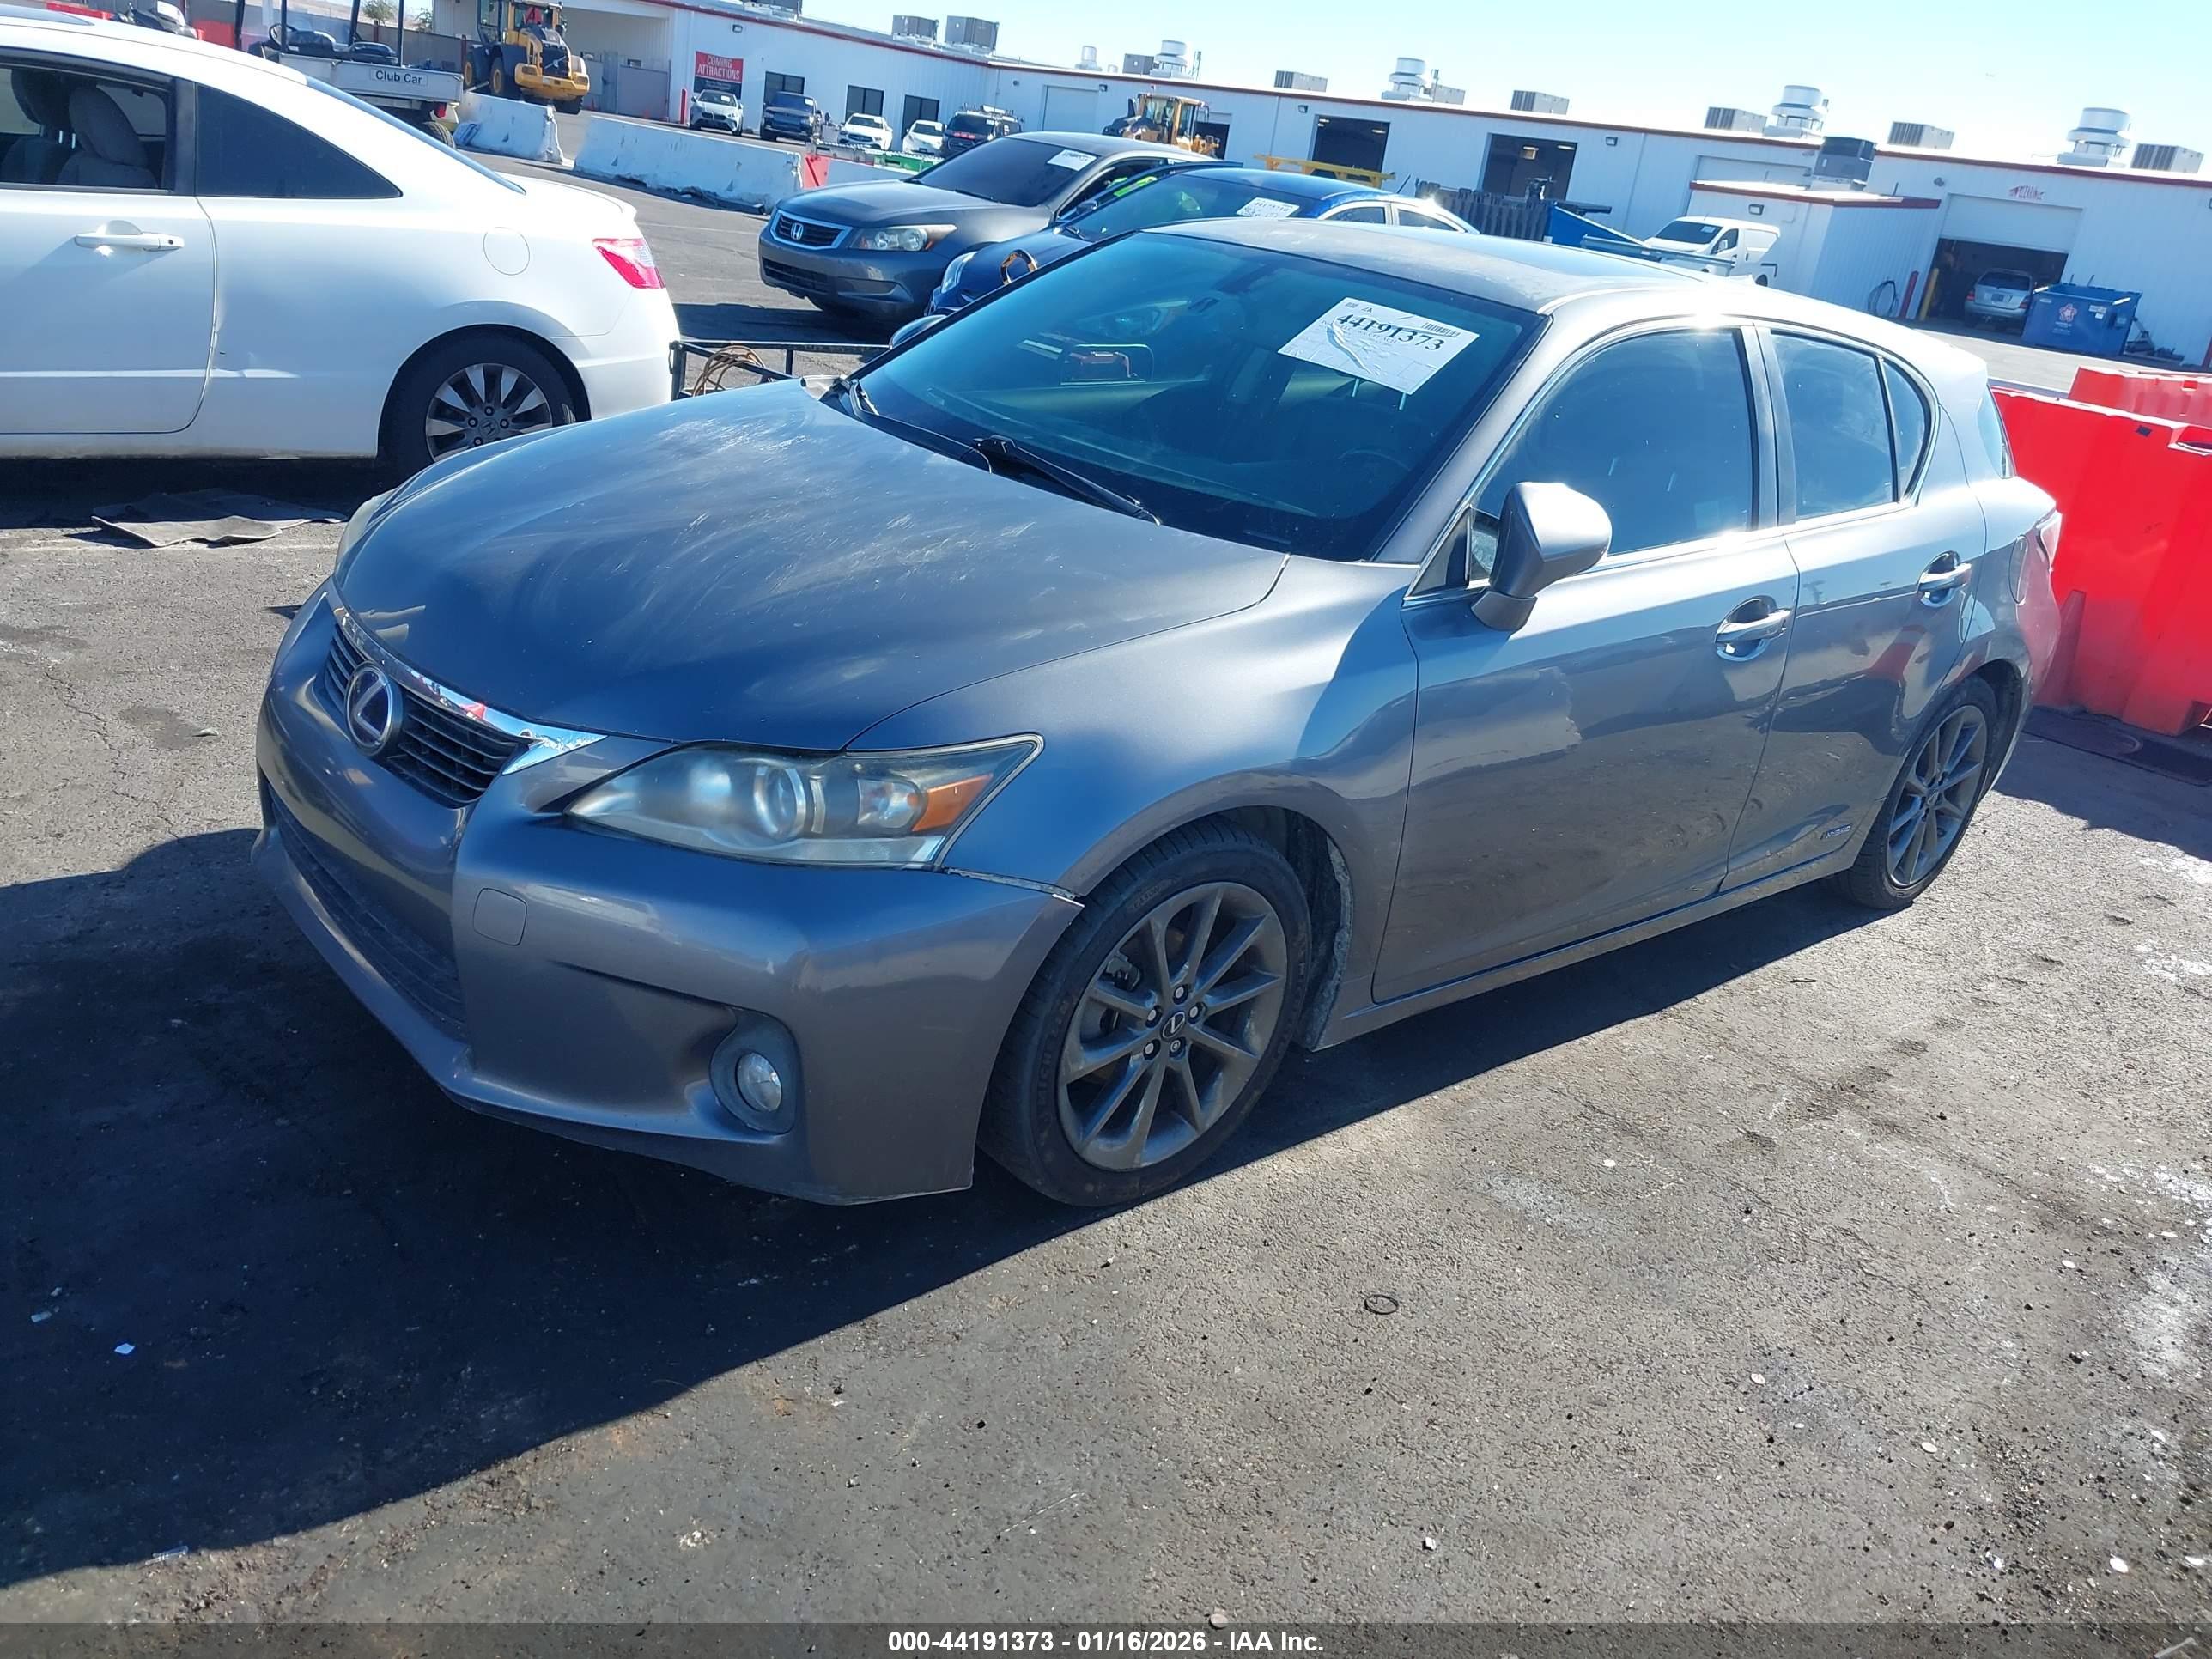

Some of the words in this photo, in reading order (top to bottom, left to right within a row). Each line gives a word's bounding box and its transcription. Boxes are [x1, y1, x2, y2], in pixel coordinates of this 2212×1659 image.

[707, 55, 732, 69] COMING
[375, 70, 401, 82] Club
[404, 73, 423, 83] Car
[697, 63, 740, 80] ATTRACTIONS
[1337, 314, 1444, 351] 44191373
